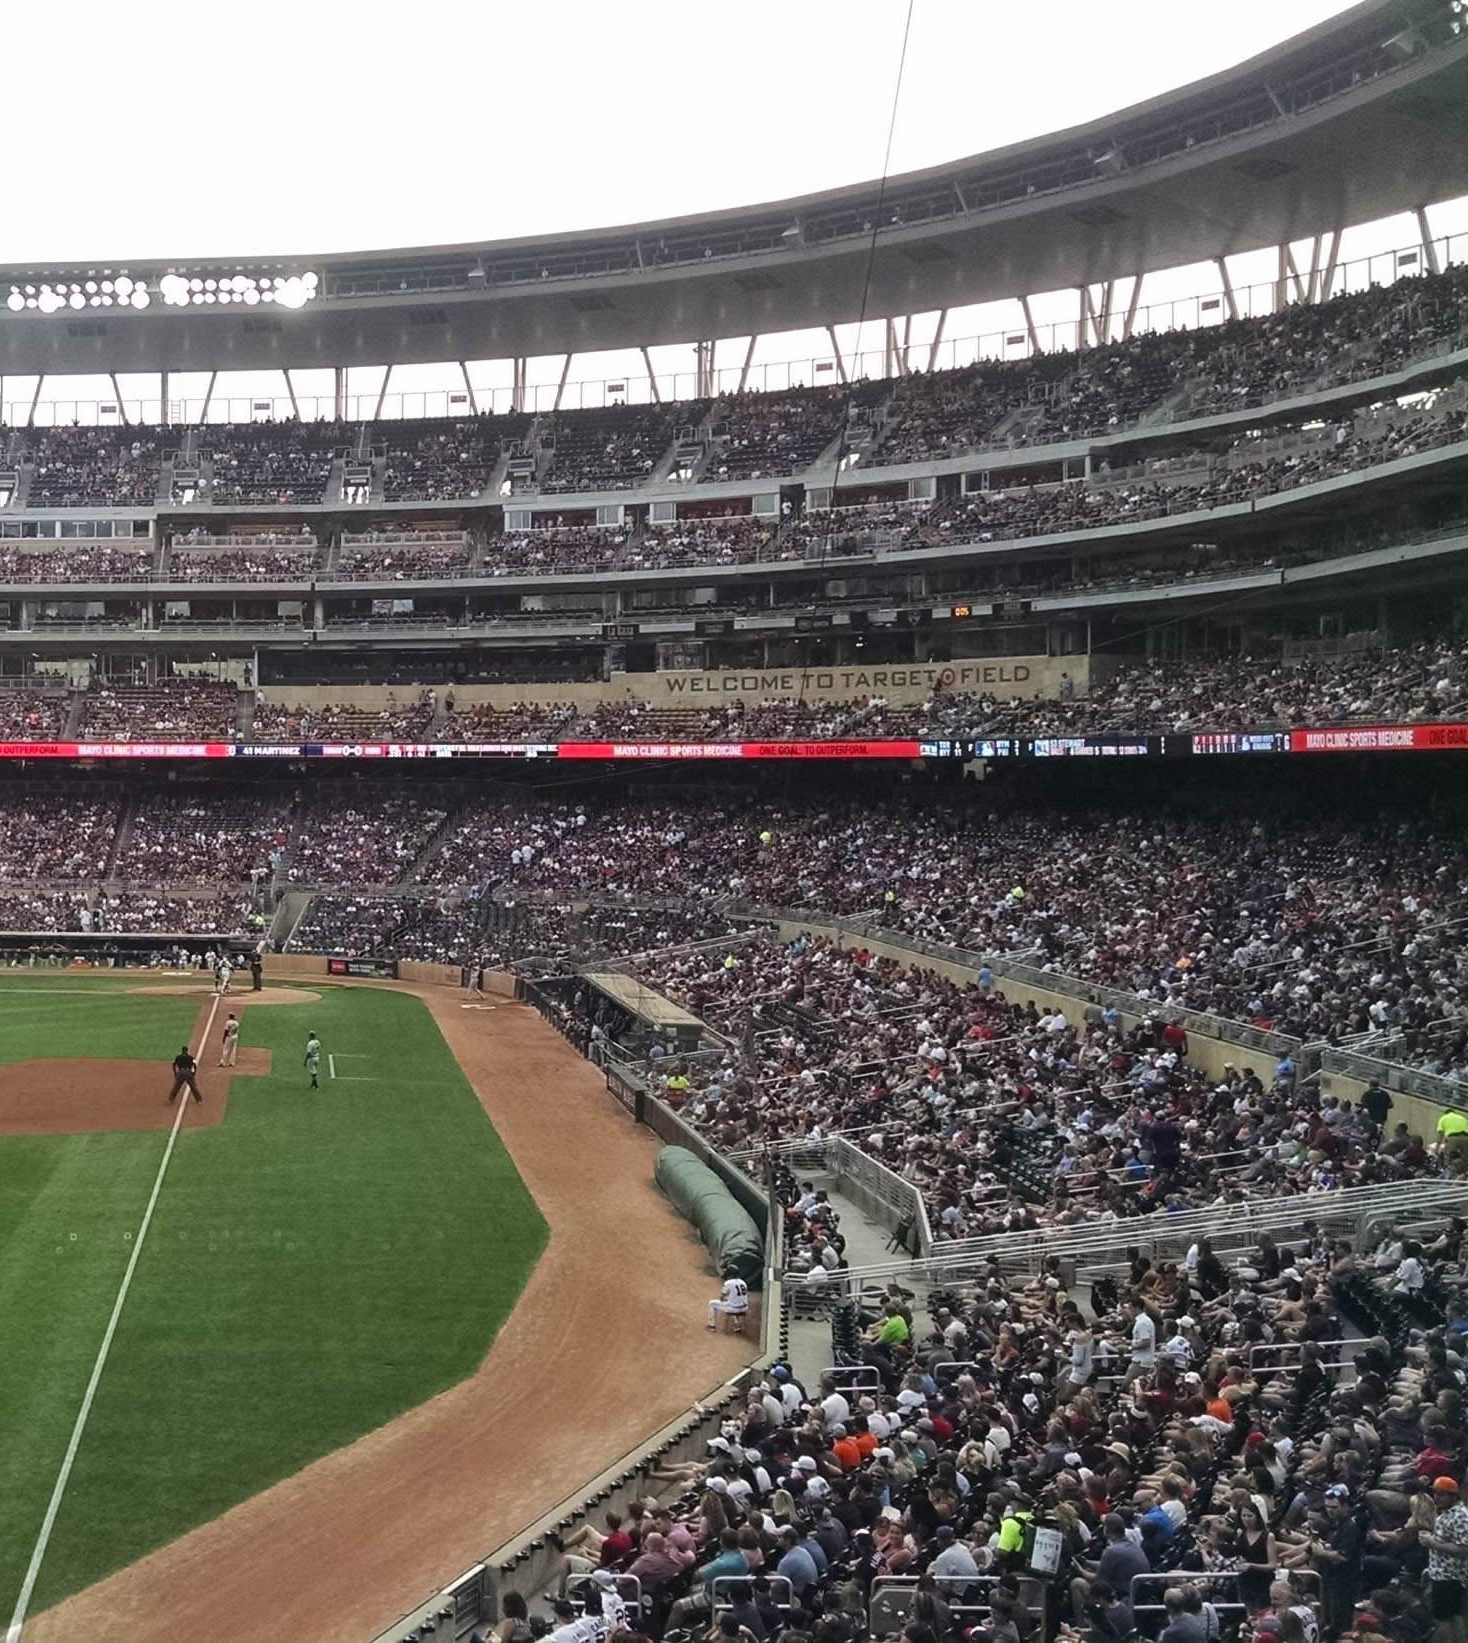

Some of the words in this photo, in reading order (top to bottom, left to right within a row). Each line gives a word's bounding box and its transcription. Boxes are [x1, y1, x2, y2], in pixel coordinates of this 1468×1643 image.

[666, 675, 794, 693] WELCOME
[801, 673, 834, 690] TO
[841, 669, 937, 689] TARGET
[961, 665, 1030, 685] FIELD
[1306, 734, 1325, 748] MAYO
[1326, 733, 1349, 748] CLINIC
[1349, 731, 1377, 747] SPORTS
[1378, 730, 1414, 746] MEDICINE
[1429, 729, 1446, 745] ONE
[79, 745, 102, 755] MAYO
[104, 745, 131, 755] CLINIC
[133, 745, 164, 755] SPORTS
[167, 745, 206, 755] MEDICINE
[254, 746, 300, 755] MARTINEZ
[614, 745, 637, 756] MAYO
[640, 745, 668, 756] CLINIC
[670, 745, 702, 756] SPORTS
[703, 745, 743, 756] MEDICINE
[760, 745, 776, 755] ONE
[804, 745, 814, 755] TO
